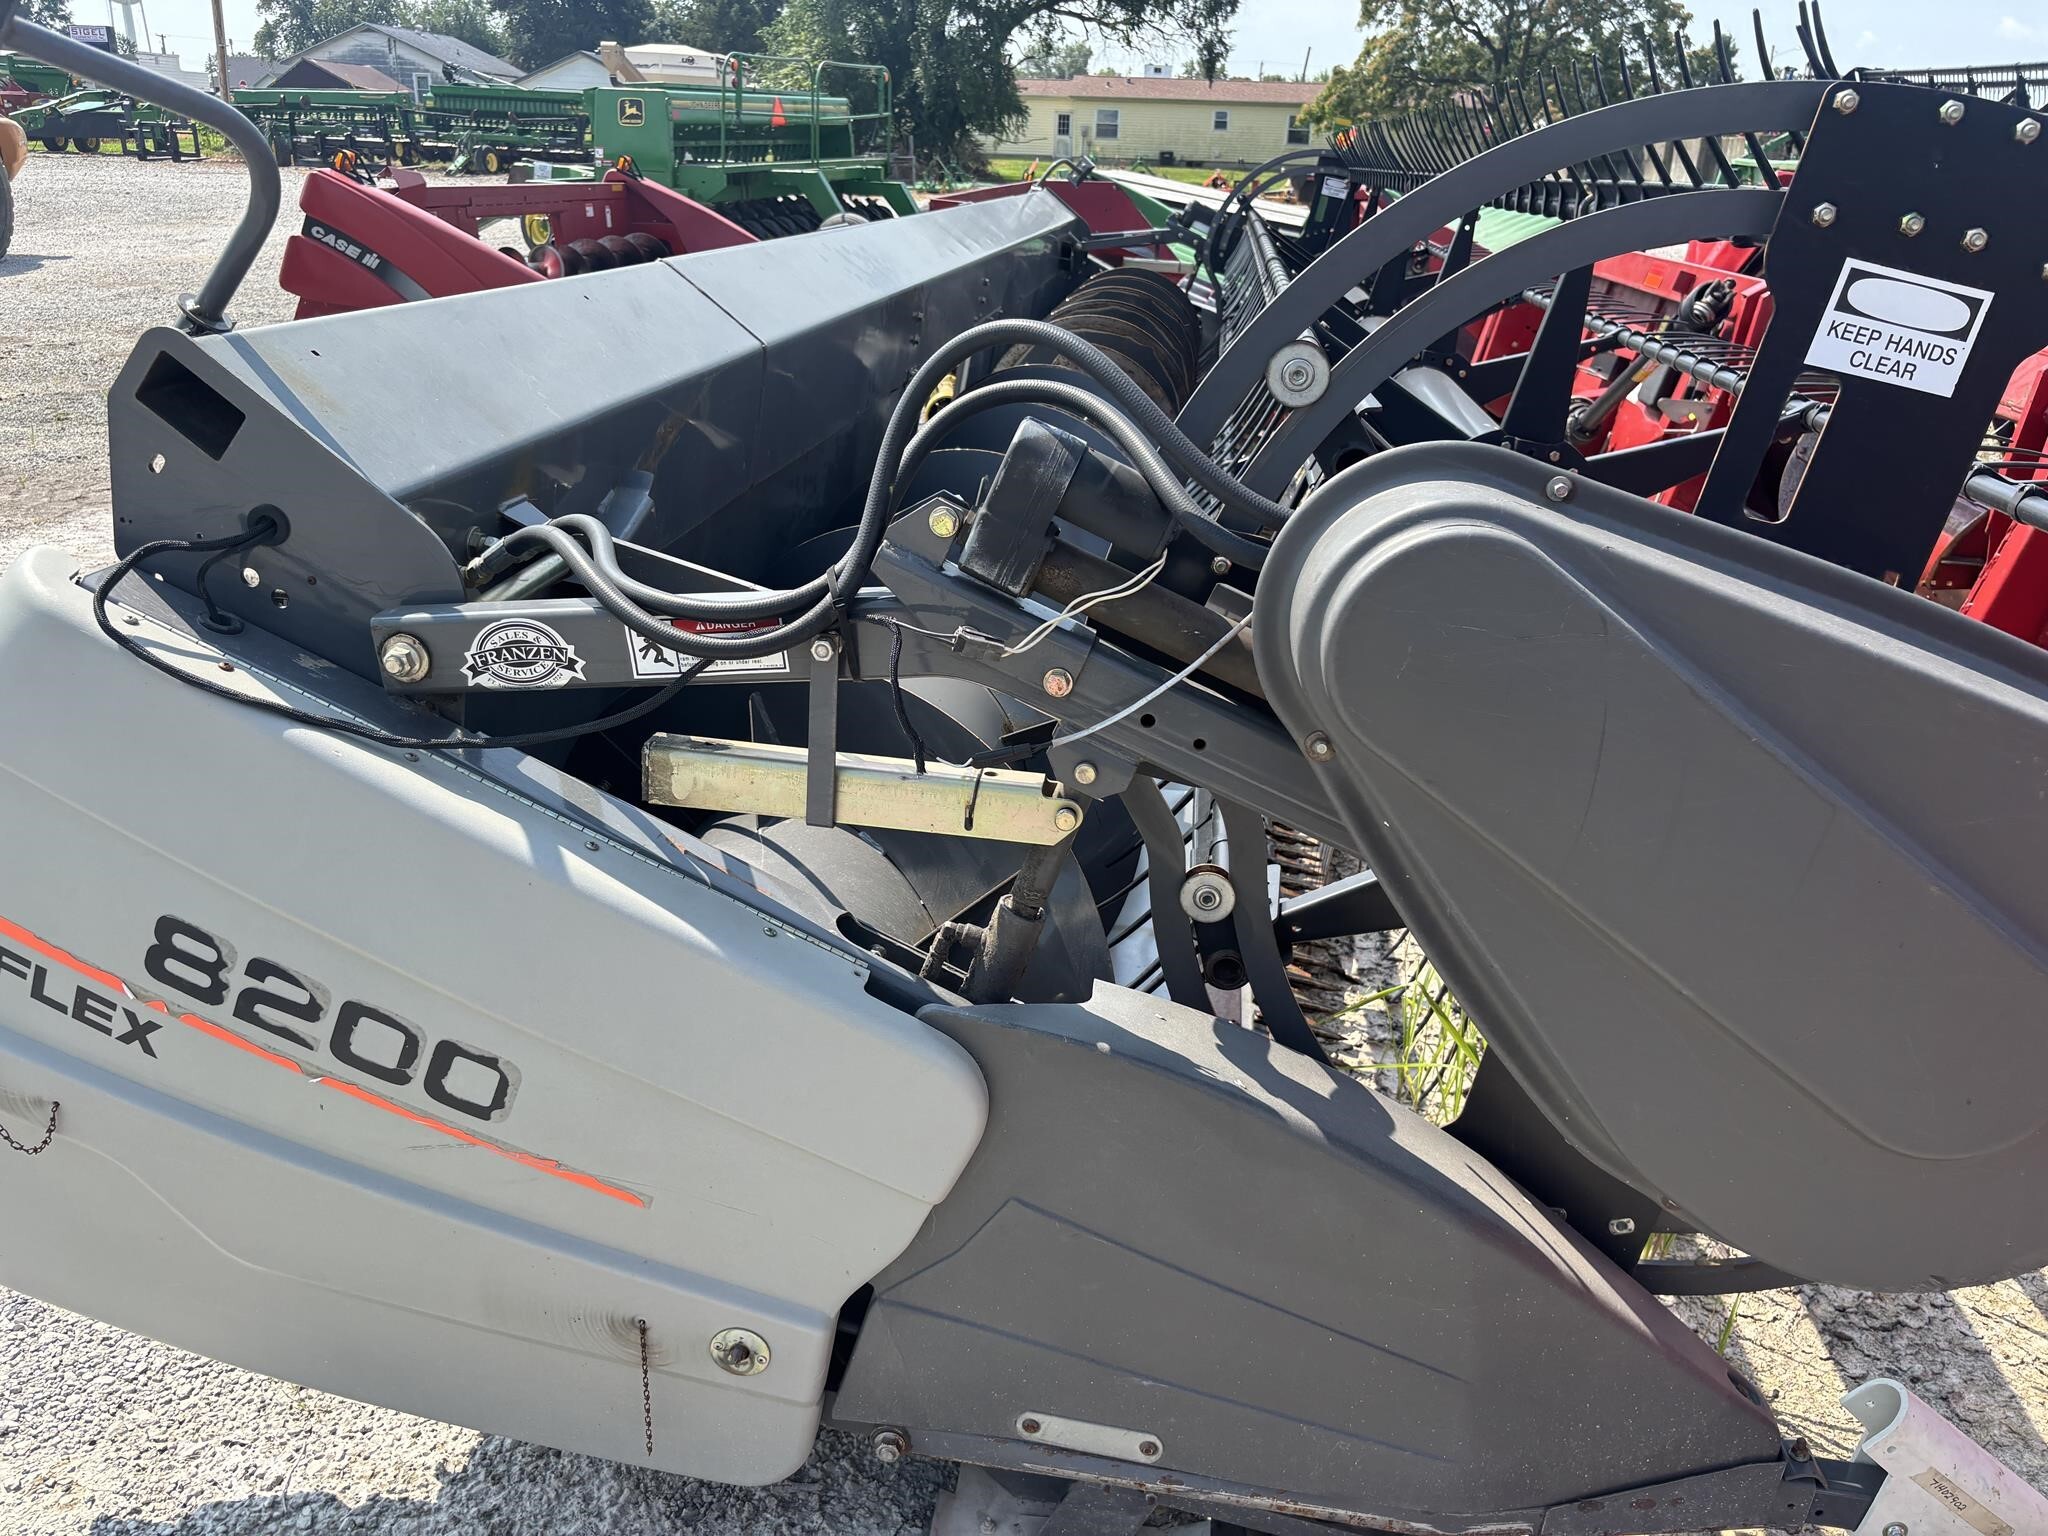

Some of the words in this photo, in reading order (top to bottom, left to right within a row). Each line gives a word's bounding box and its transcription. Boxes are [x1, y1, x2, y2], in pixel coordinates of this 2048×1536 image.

[71, 28, 105, 36] SIGEL
[311, 226, 362, 260] CASE
[1826, 320, 1882, 346] KEEP
[1885, 334, 1958, 366] HANDS
[1849, 350, 1917, 381] CLEAR
[490, 631, 529, 648] SALES
[533, 635, 542, 645] &
[473, 646, 567, 668] FRANZEN
[497, 661, 549, 677] SERVICE
[0, 945, 164, 1060] FLEX
[144, 914, 521, 1122] 8200
